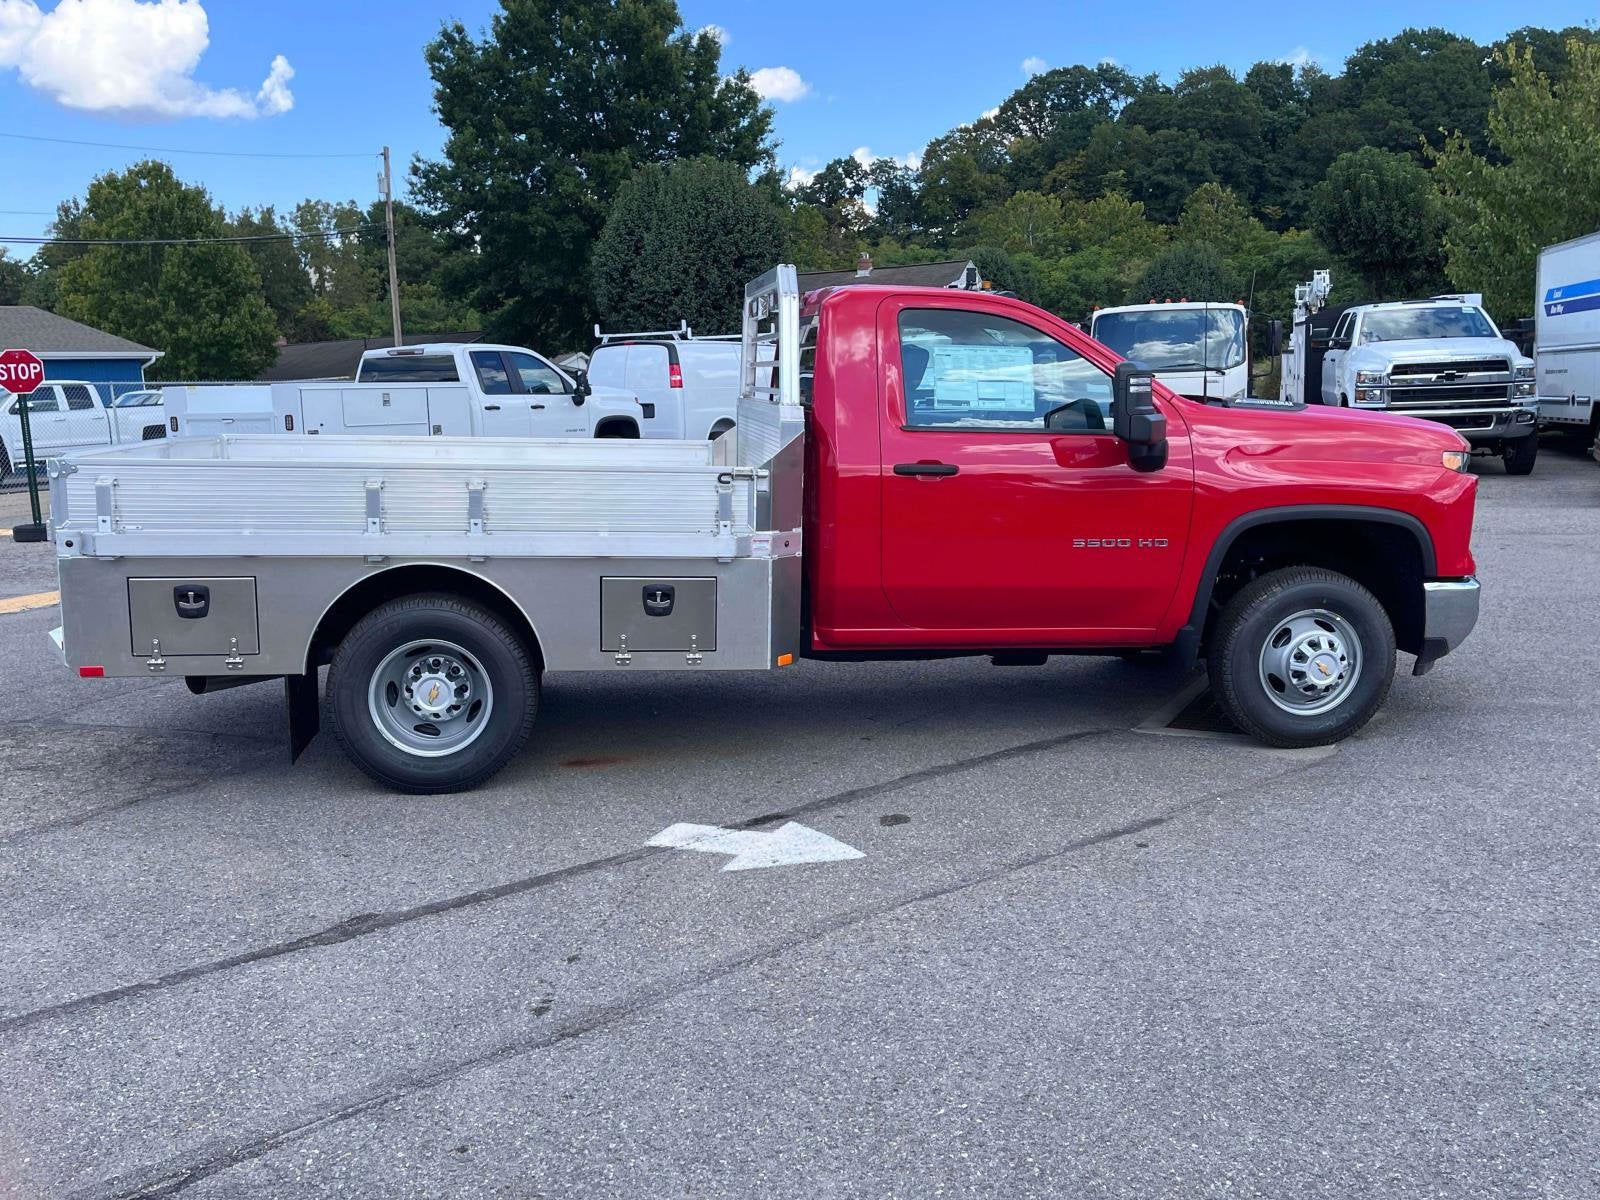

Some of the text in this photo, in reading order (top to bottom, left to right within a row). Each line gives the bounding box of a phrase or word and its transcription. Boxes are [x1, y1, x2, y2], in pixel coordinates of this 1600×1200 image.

[0, 363, 41, 380] STOP
[1072, 538, 1169, 548] 3500 HD
